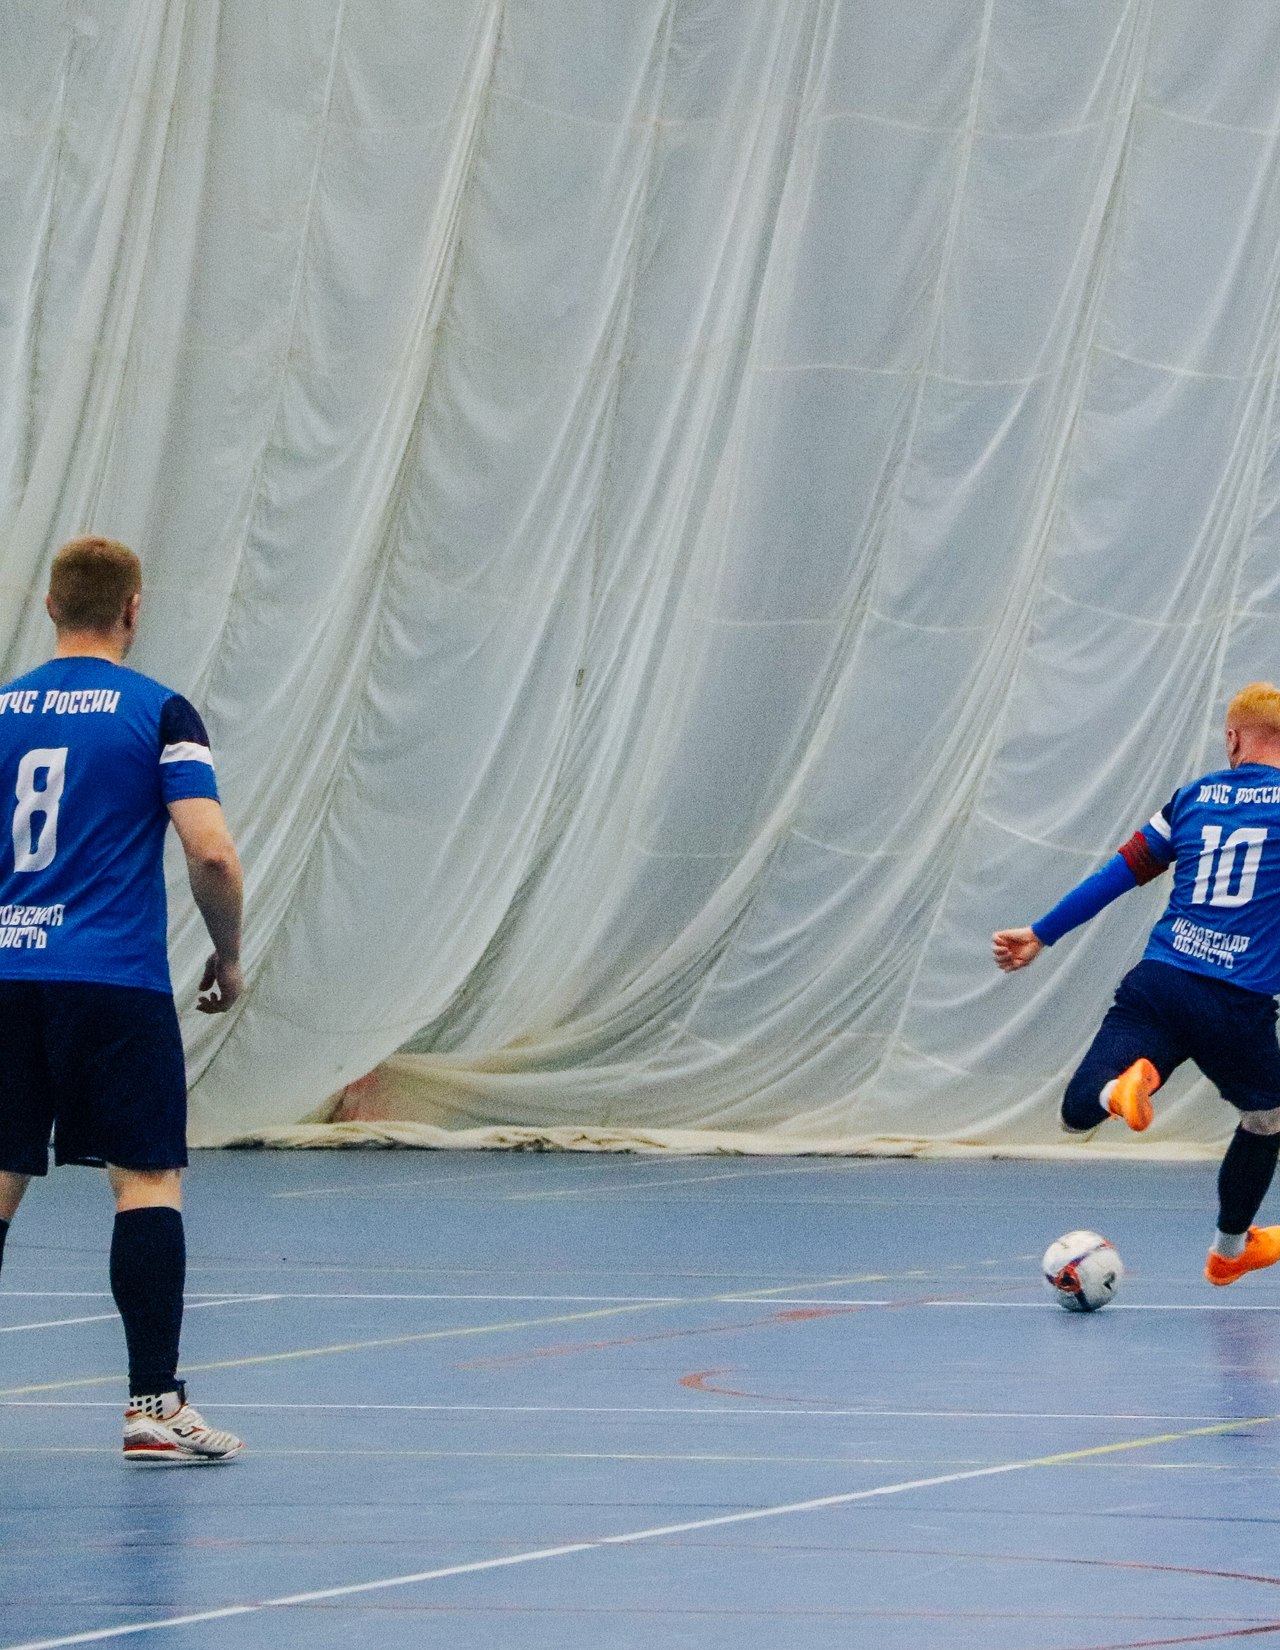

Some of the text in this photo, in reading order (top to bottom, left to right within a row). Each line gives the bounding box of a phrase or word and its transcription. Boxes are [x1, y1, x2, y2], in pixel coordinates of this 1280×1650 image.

[42, 689, 121, 715] РОССИИ
[12, 747, 69, 873] 8
[1196, 784, 1232, 804] МЧС
[1191, 825, 1268, 909] 10
[0, 904, 66, 927] ОВСКАЯ
[1171, 917, 1250, 953] ПСКОВСКАЯ
[1172, 934, 1235, 970] ОБЛАСТЬ
